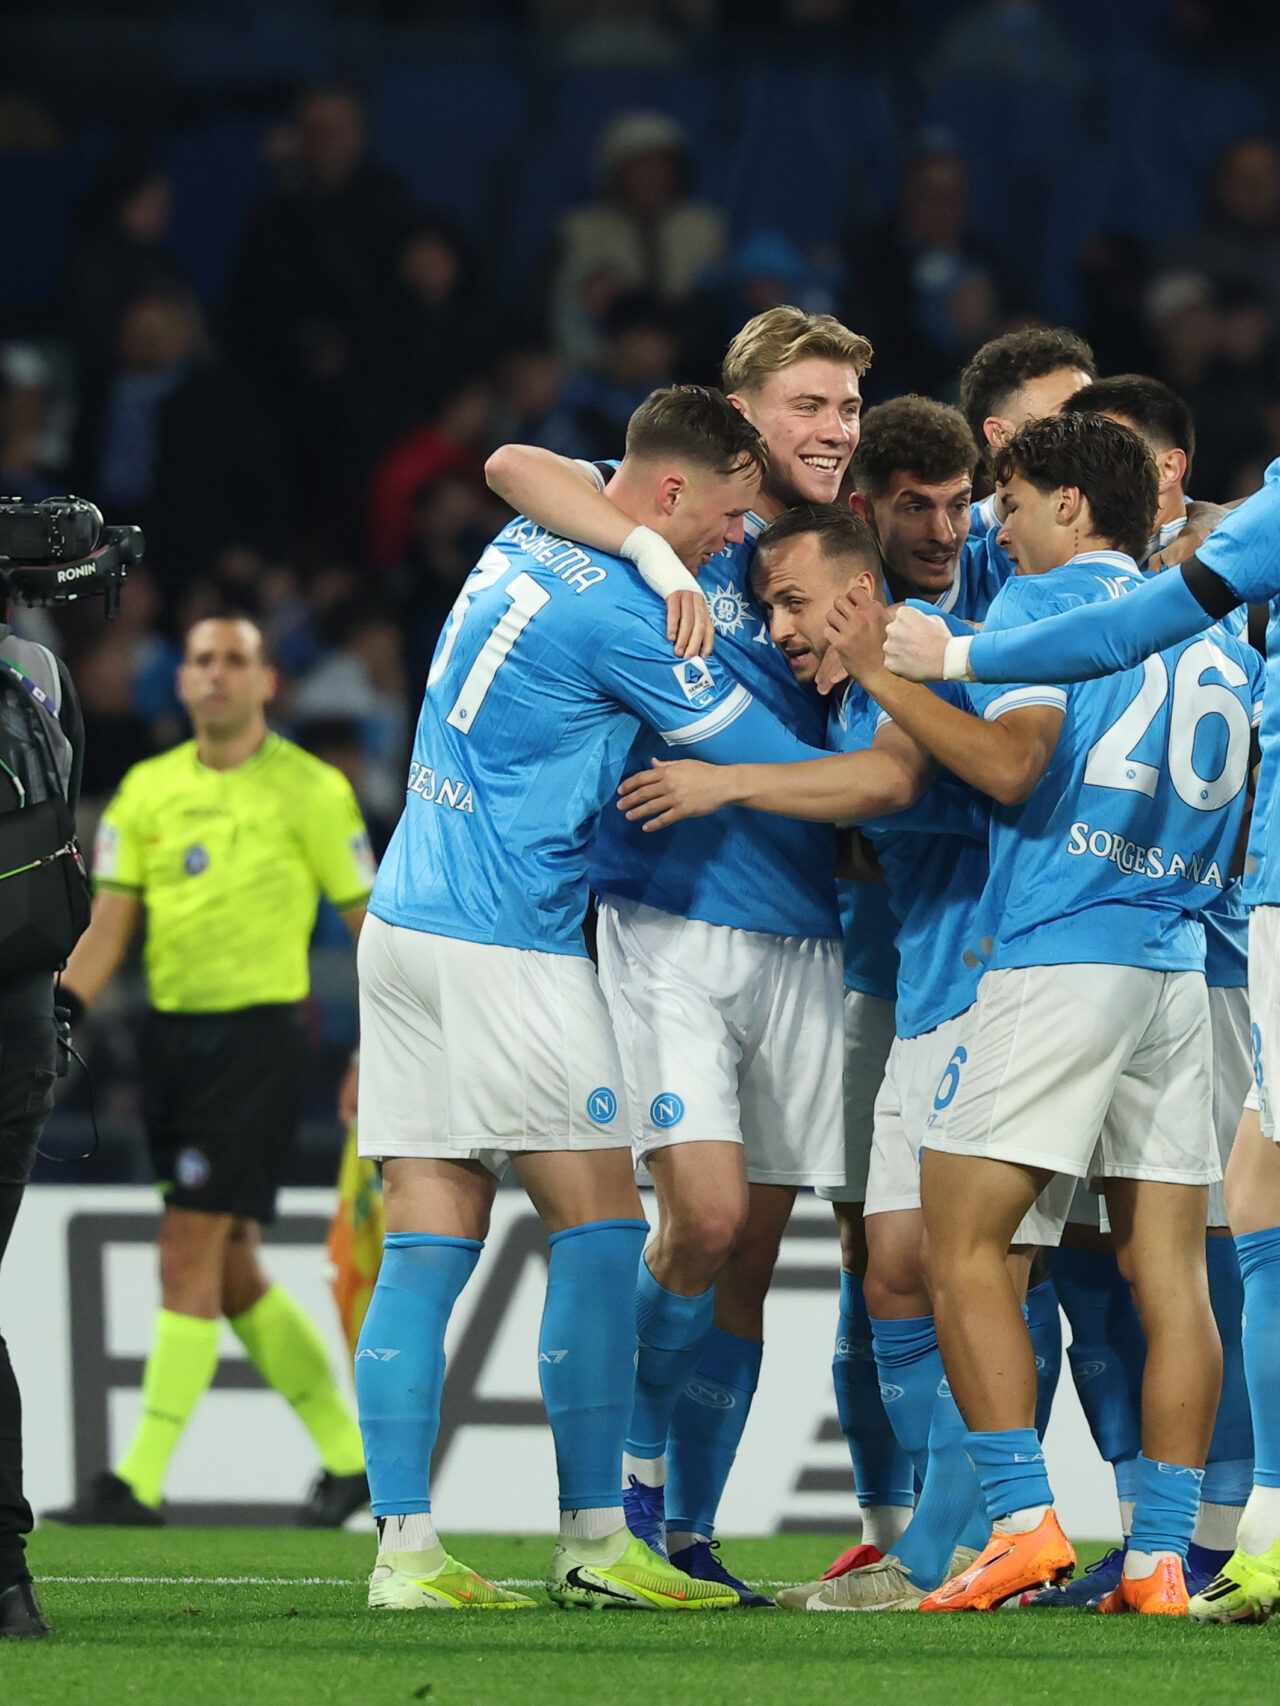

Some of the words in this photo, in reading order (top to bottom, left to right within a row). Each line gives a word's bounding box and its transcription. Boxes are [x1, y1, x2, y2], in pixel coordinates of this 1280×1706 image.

[57, 562, 97, 583] RONIN
[1083, 639, 1251, 812] 26
[1067, 822, 1224, 888] SORGESANA
[934, 1045, 967, 1110] 6
[355, 1347, 401, 1361] A7
[538, 1349, 568, 1364] A7
[1014, 1453, 1045, 1463] EA
